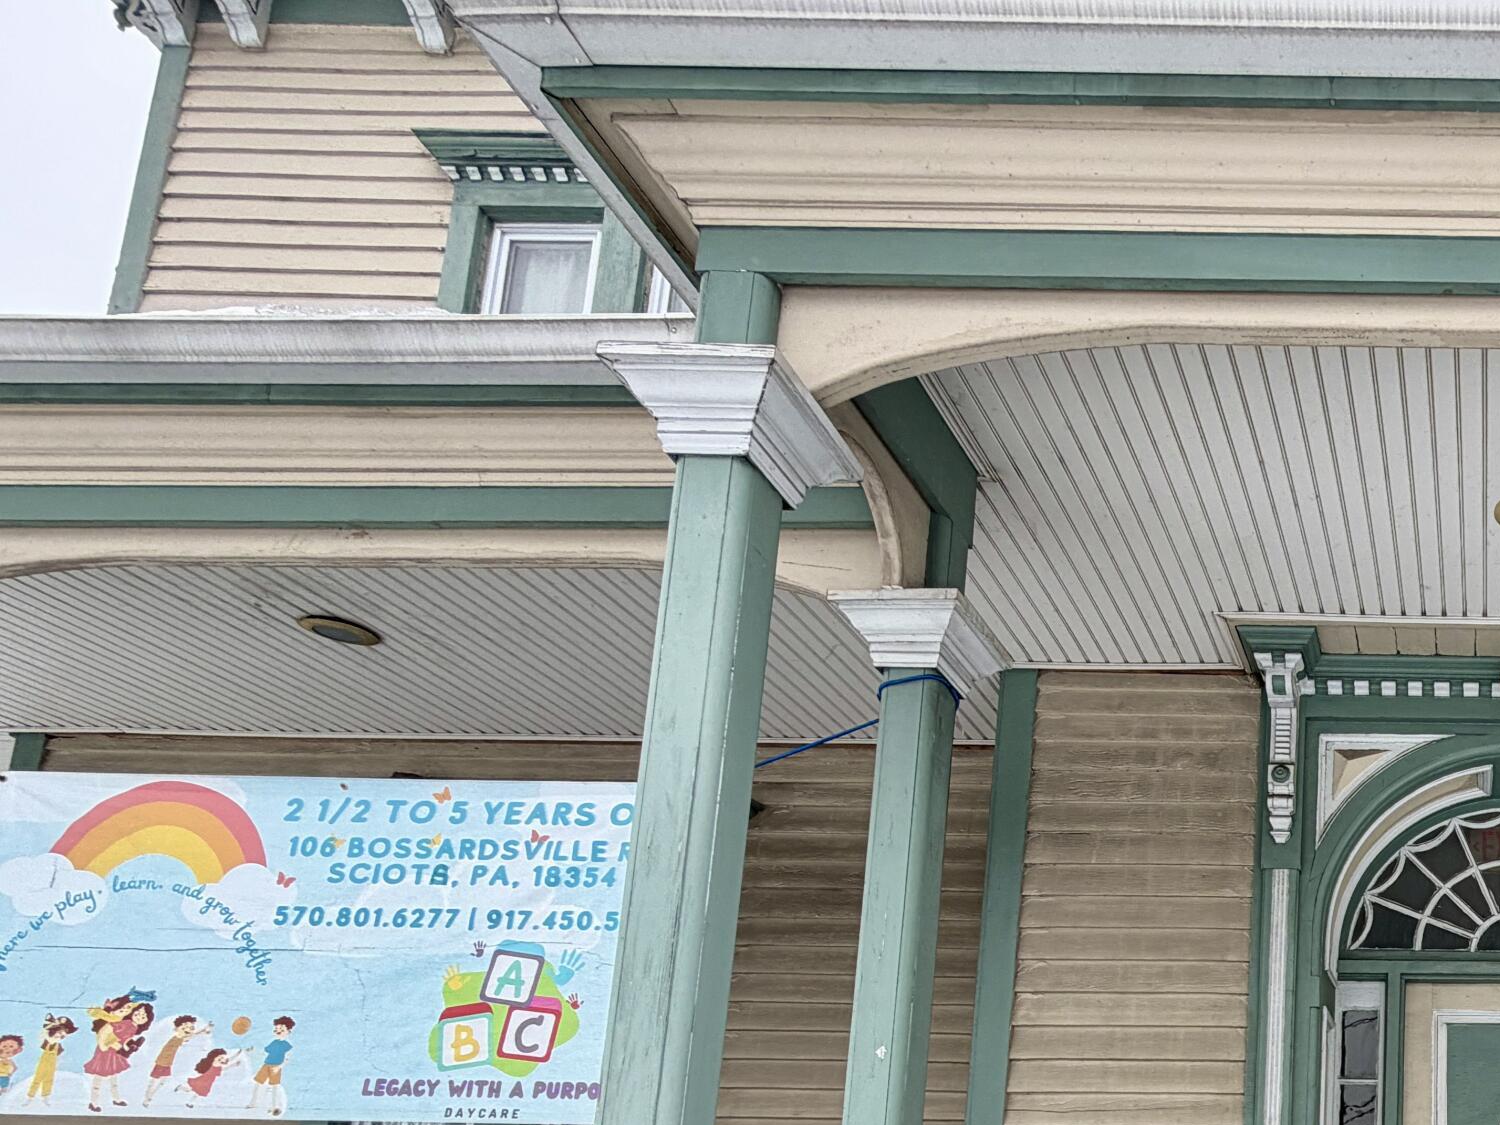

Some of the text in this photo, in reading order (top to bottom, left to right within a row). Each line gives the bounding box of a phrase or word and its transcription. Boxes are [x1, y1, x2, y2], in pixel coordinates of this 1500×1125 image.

[283, 798, 304, 822] 2
[318, 797, 371, 824] 1/2
[386, 799, 437, 824] TO
[449, 800, 469, 825] 5
[484, 801, 597, 826] YEARS
[289, 836, 338, 857] 106
[347, 837, 609, 862] BOSSARDSVILLE
[470, 865, 519, 888] PA,
[533, 865, 616, 888] 18354
[273, 905, 461, 929] 570.801.6277
[29, 911, 53, 930] we
[172, 881, 207, 901] and
[200, 896, 240, 926] grow
[232, 920, 273, 986] together
[494, 959, 525, 998] A
[451, 1015, 545, 1062] B C
[362, 1078, 440, 1097] LEGACY
[448, 1080, 502, 1099] WITH
[509, 1081, 524, 1098] A
[444, 1107, 521, 1119] DAYCARE
